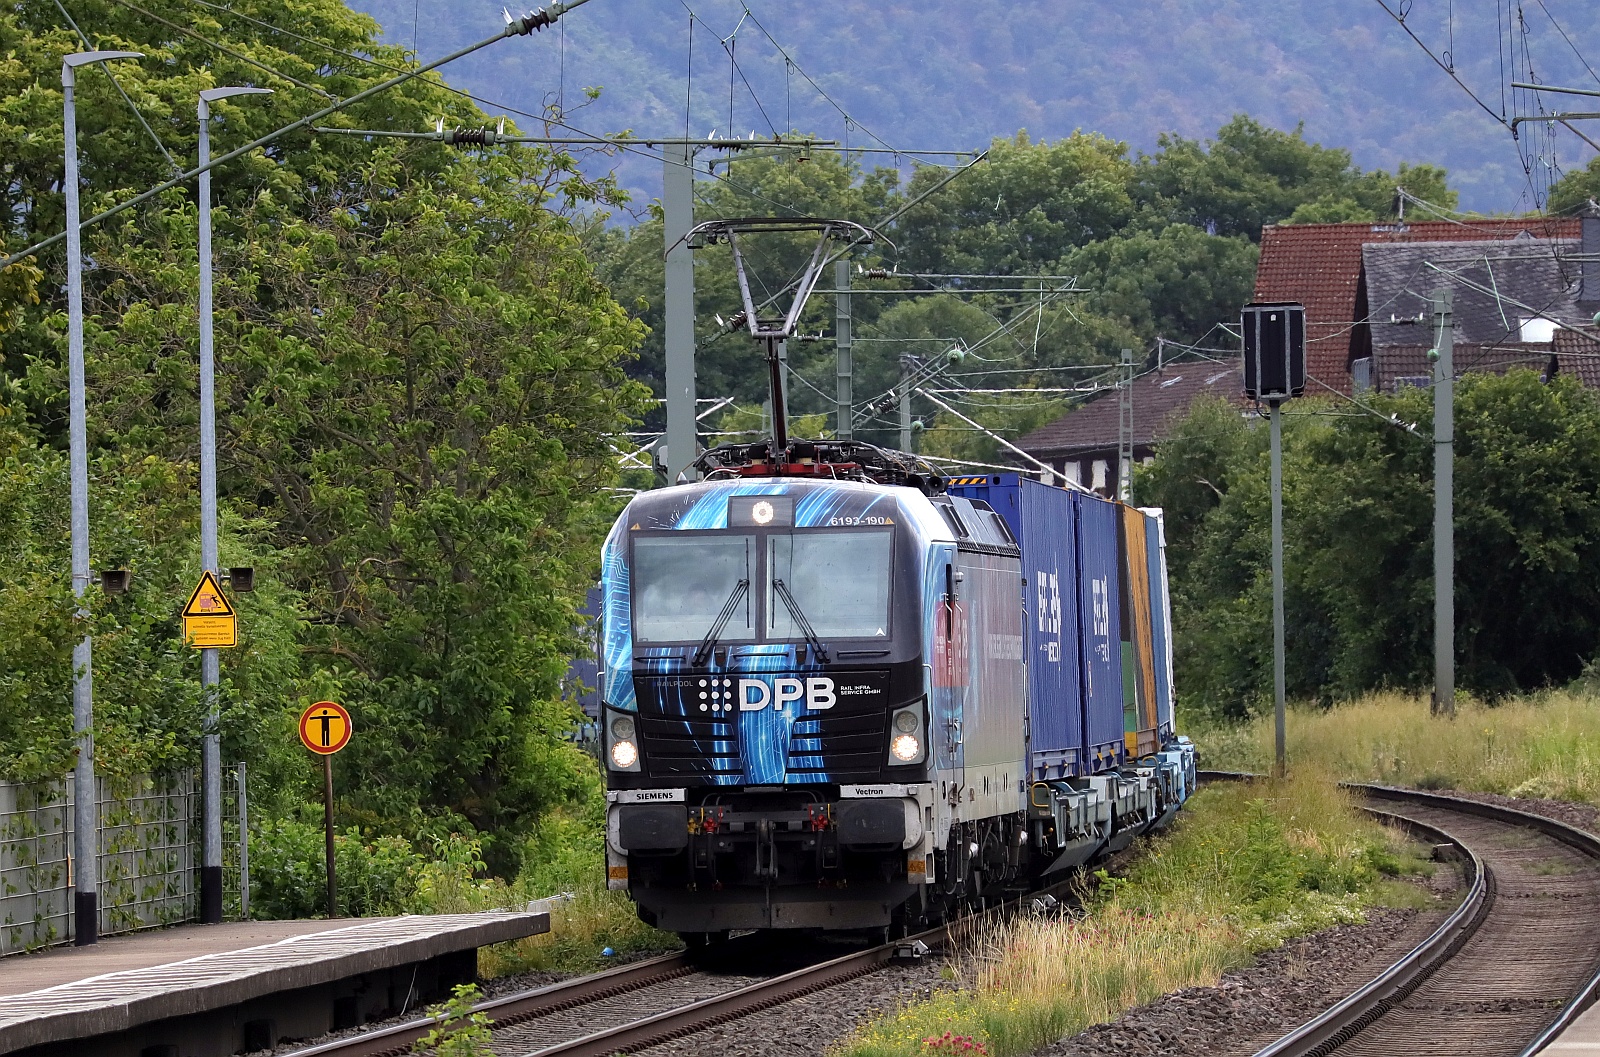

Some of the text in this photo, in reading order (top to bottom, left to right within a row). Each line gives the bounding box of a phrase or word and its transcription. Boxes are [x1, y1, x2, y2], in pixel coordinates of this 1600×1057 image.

[831, 516, 885, 526] 6193-190
[656, 680, 694, 688] RAILPOOL
[738, 677, 837, 712] DPB
[636, 792, 674, 801] SIEMENS
[855, 788, 884, 796] Vectron
